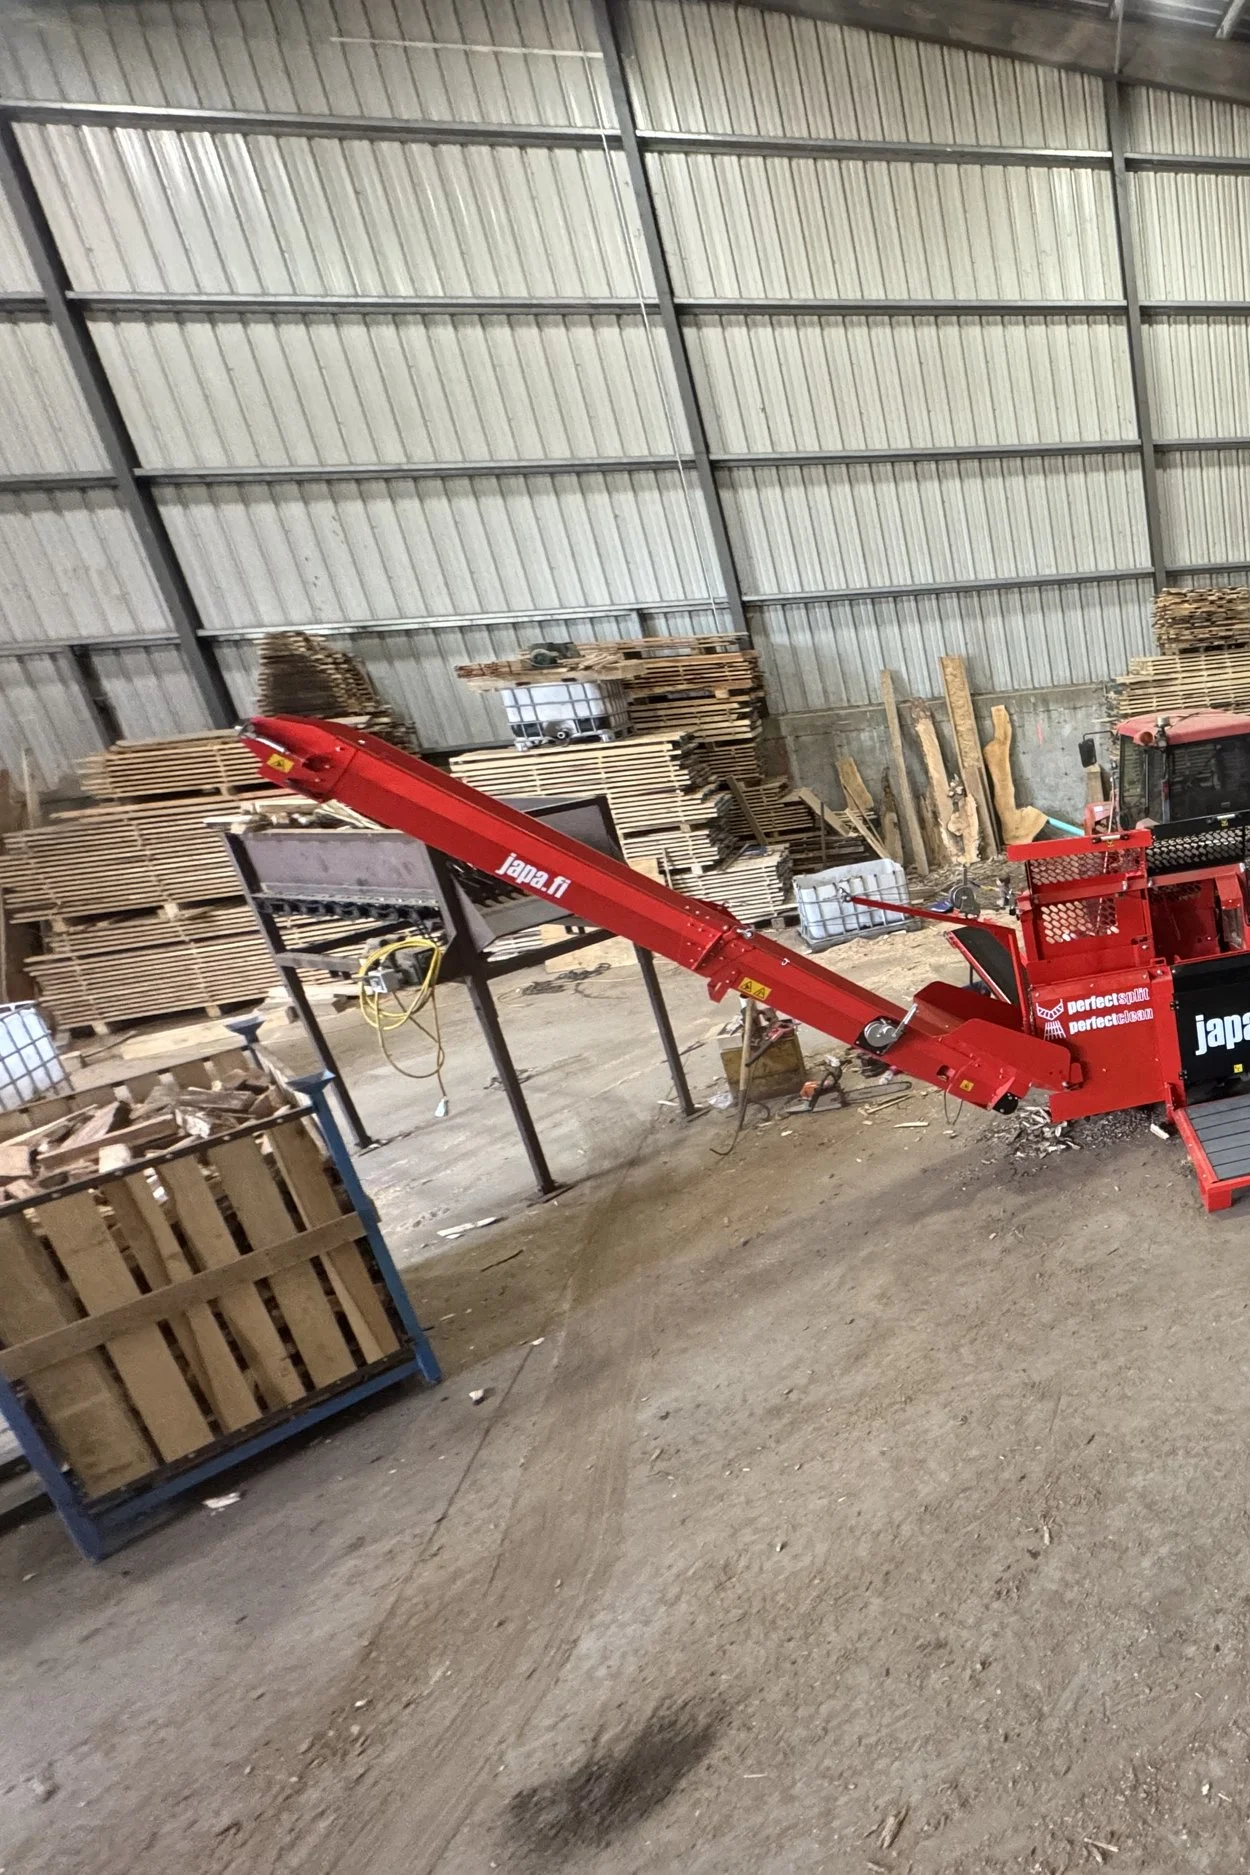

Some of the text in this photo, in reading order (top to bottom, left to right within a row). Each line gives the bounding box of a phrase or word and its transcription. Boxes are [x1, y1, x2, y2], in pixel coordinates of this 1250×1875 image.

[494, 852, 571, 899] japa.fi
[1066, 987, 1151, 1016] perfectsplit
[1068, 1008, 1154, 1035] perfectclean
